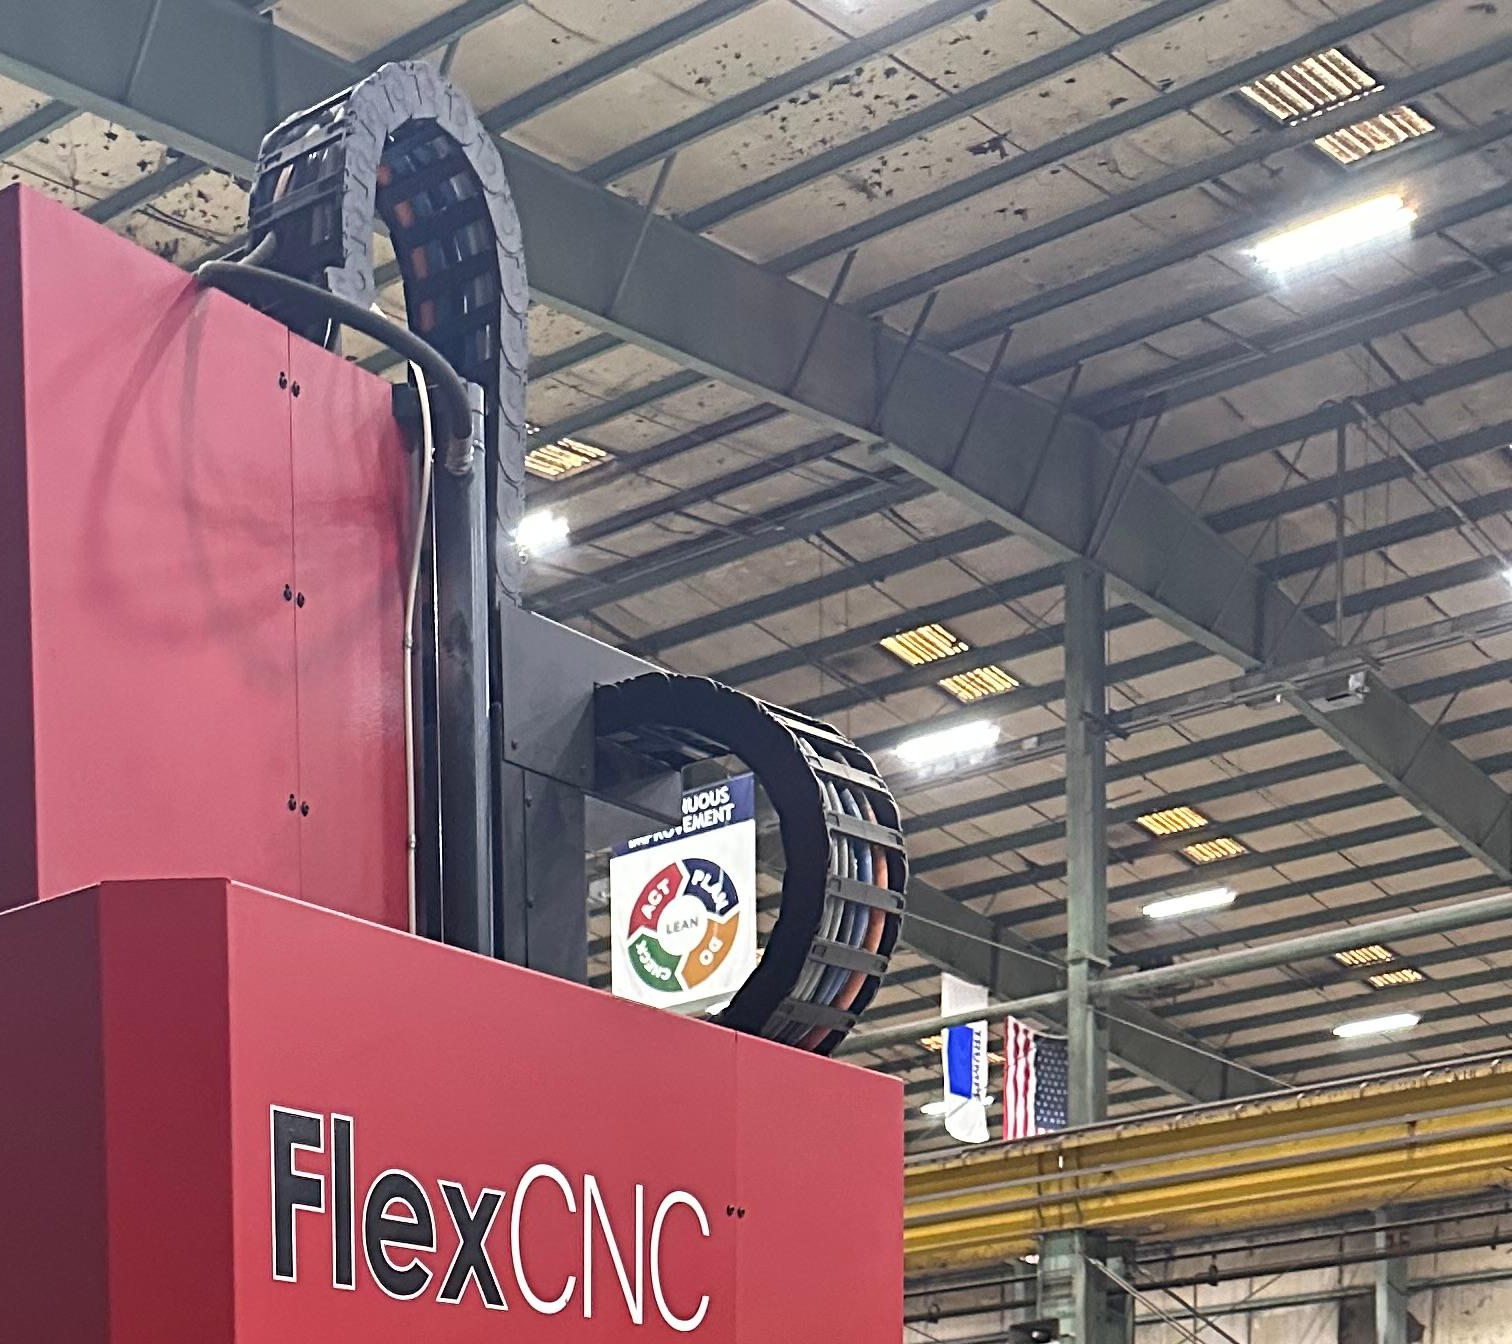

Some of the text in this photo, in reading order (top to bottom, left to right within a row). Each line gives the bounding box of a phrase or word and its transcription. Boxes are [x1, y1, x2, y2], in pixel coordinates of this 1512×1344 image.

[640, 878, 671, 920] ACT
[691, 869, 729, 911] PLAN
[666, 916, 699, 935] LEAN
[699, 936, 723, 965] DO
[270, 1103, 710, 1333] FlexCNC
